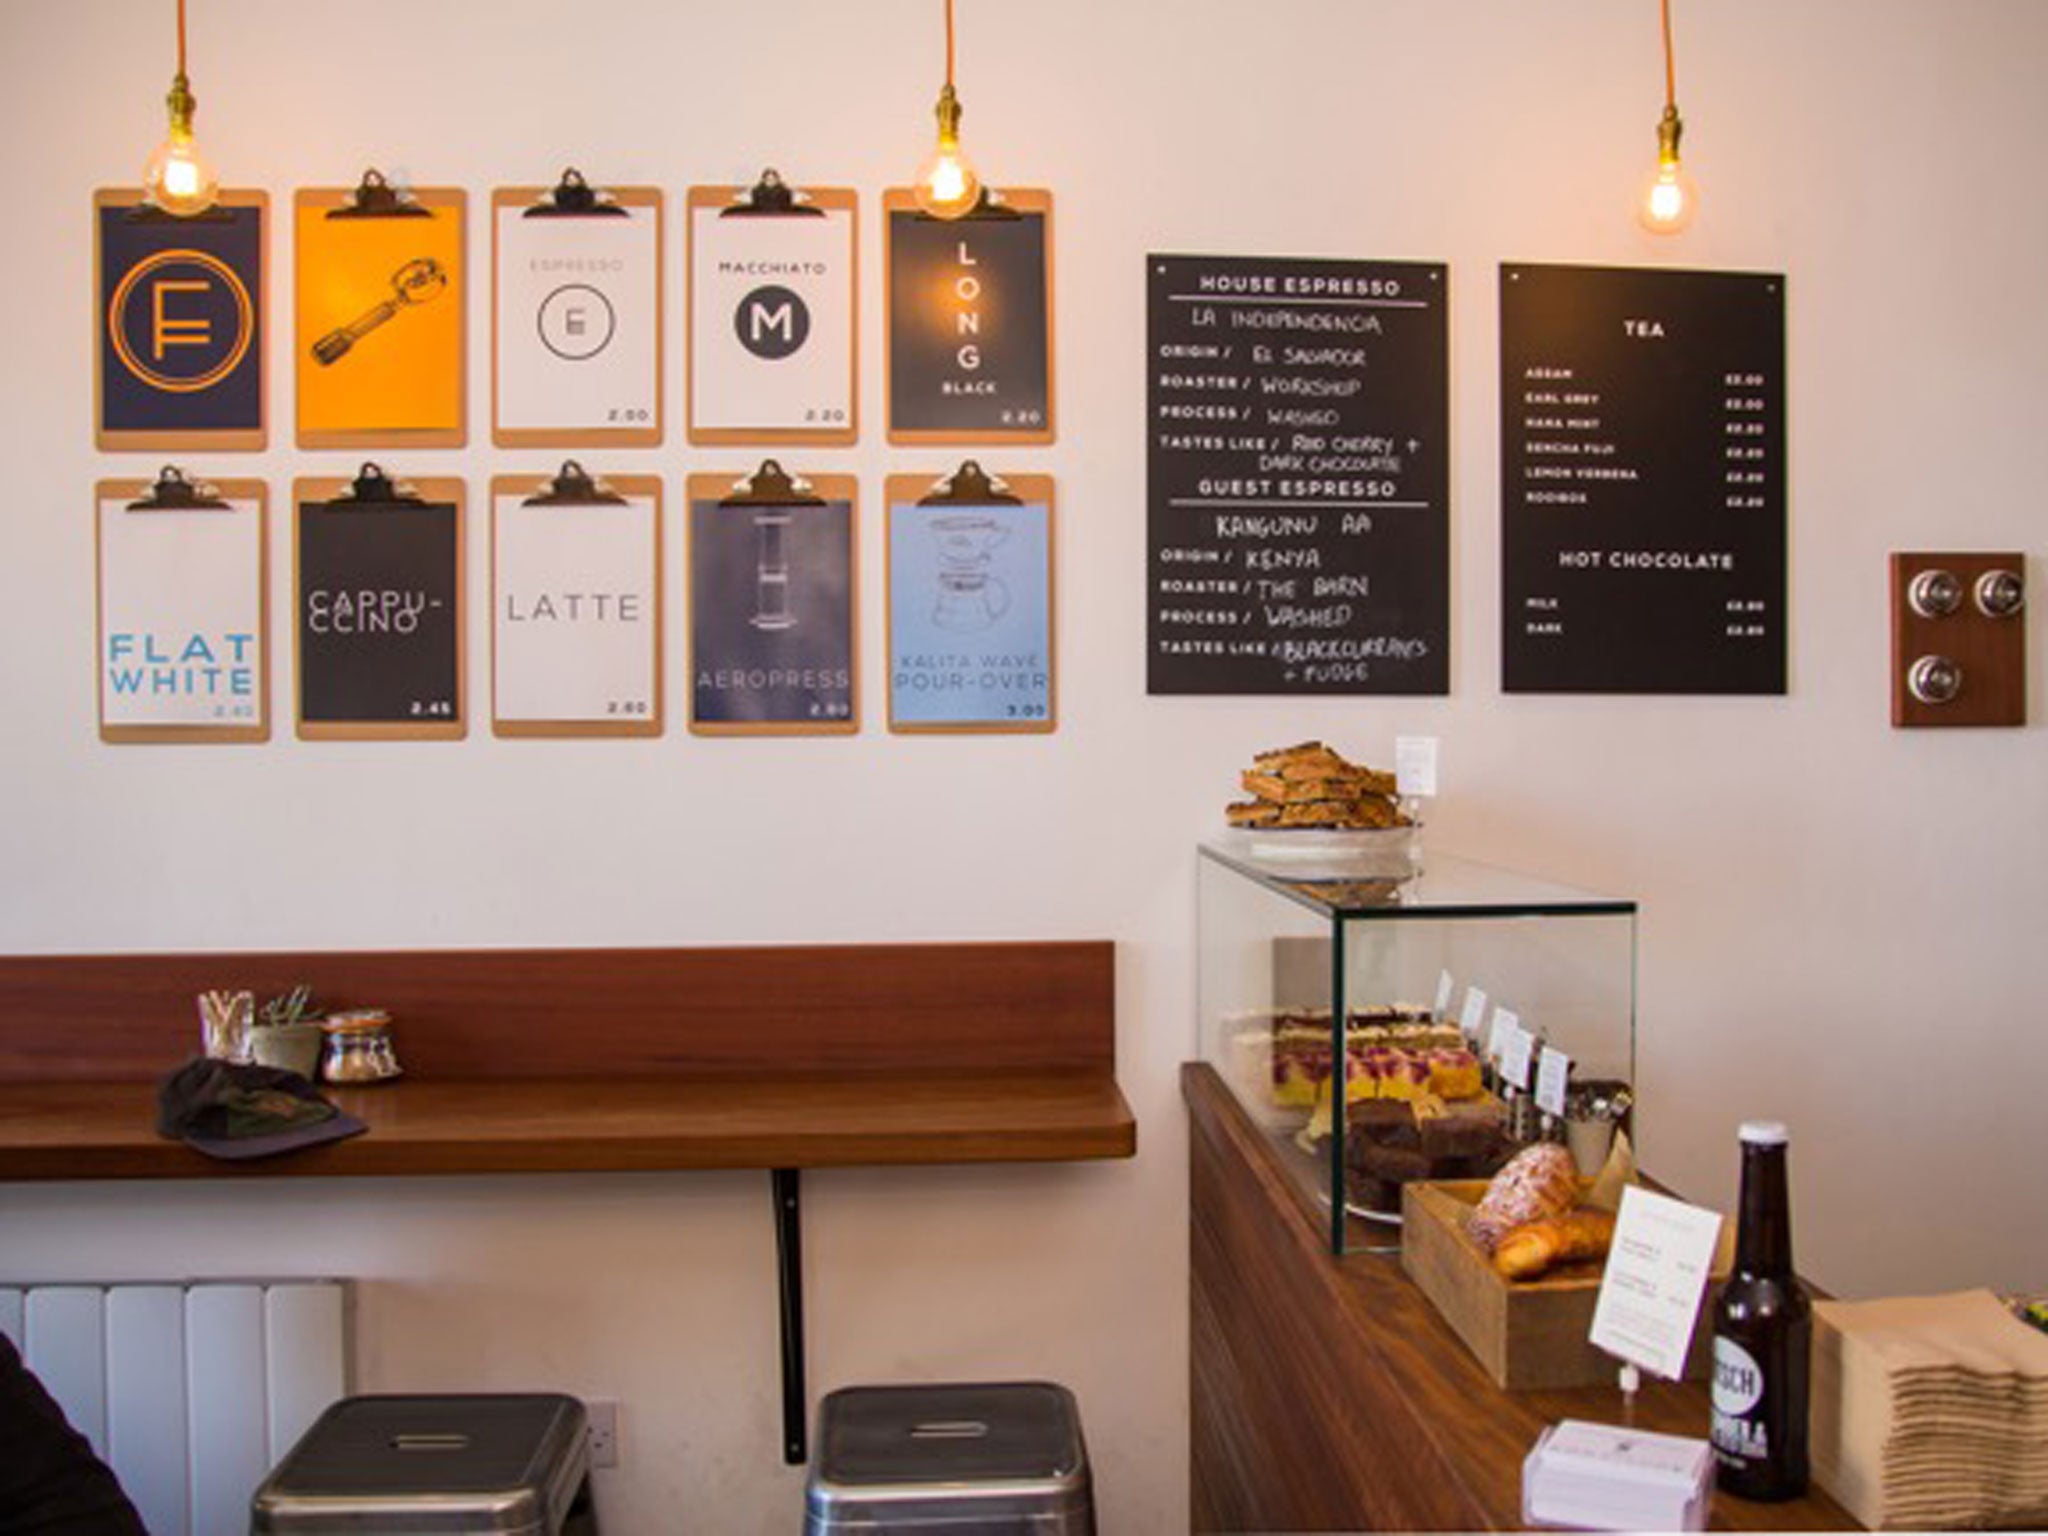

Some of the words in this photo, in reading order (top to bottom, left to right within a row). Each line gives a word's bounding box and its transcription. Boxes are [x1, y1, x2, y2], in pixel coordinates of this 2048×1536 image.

[528, 258, 624, 272] ESPRESSO
[718, 260, 827, 275] MACCHIATO
[1199, 275, 1277, 293] HOUSE
[1284, 277, 1401, 297] ESPRESSO
[956, 241, 983, 371] LONG
[751, 303, 792, 341] M
[1191, 308, 1217, 327] LA
[1230, 309, 1384, 335] INDEPENDENCIA
[1623, 319, 1665, 338] TEA
[1159, 345, 1219, 358] ORIGIN
[1252, 345, 1273, 363] EL
[1284, 347, 1367, 366] SALVADOR
[1524, 367, 1573, 379] ASSAM
[942, 381, 998, 395] BLACK
[1159, 375, 1238, 390] ROASTER
[1260, 377, 1362, 397] WORKSHOP
[1524, 393, 1561, 405] EARL
[1562, 393, 1600, 405] GREY
[1159, 405, 1238, 418] PROCESS
[1267, 409, 1340, 426] WASHED
[1566, 418, 1601, 429] MINT
[1159, 435, 1224, 450] TASTES
[1229, 437, 1266, 451] LIKE
[1525, 442, 1580, 454] SENCHA
[1259, 454, 1305, 473] DARK
[1524, 466, 1572, 478] LEMON
[1575, 468, 1639, 480] VERBENA
[1198, 480, 1272, 496] GUEST
[1279, 481, 1397, 497] ESPRESSO
[1525, 491, 1588, 504] ROOIBOS
[1341, 513, 1373, 535] AA
[1159, 549, 1219, 563] ORIGIN
[1245, 549, 1321, 570] KENYA
[1558, 552, 1602, 567] HOT
[1608, 552, 1734, 570] CHOCOLATE
[1159, 580, 1238, 594] ROASTER
[1257, 579, 1296, 600] THE
[1312, 575, 1370, 597] BARN
[507, 594, 640, 622] LATTE
[1525, 597, 1559, 609] MILK
[309, 611, 419, 634] CCINO
[1159, 609, 1238, 624] PROCESS
[1263, 604, 1353, 629] WASHED
[1525, 622, 1563, 635] DARK
[108, 634, 254, 662] FLAT
[1159, 640, 1224, 655] TASTES
[1229, 641, 1266, 655] LIKE
[900, 653, 972, 669] KALITA
[978, 653, 1040, 669] WAVE
[108, 668, 252, 696] WHITE
[696, 669, 850, 690] AEROPRESS
[895, 672, 1047, 690] POUR-OVER
[410, 701, 452, 716] 2.45
